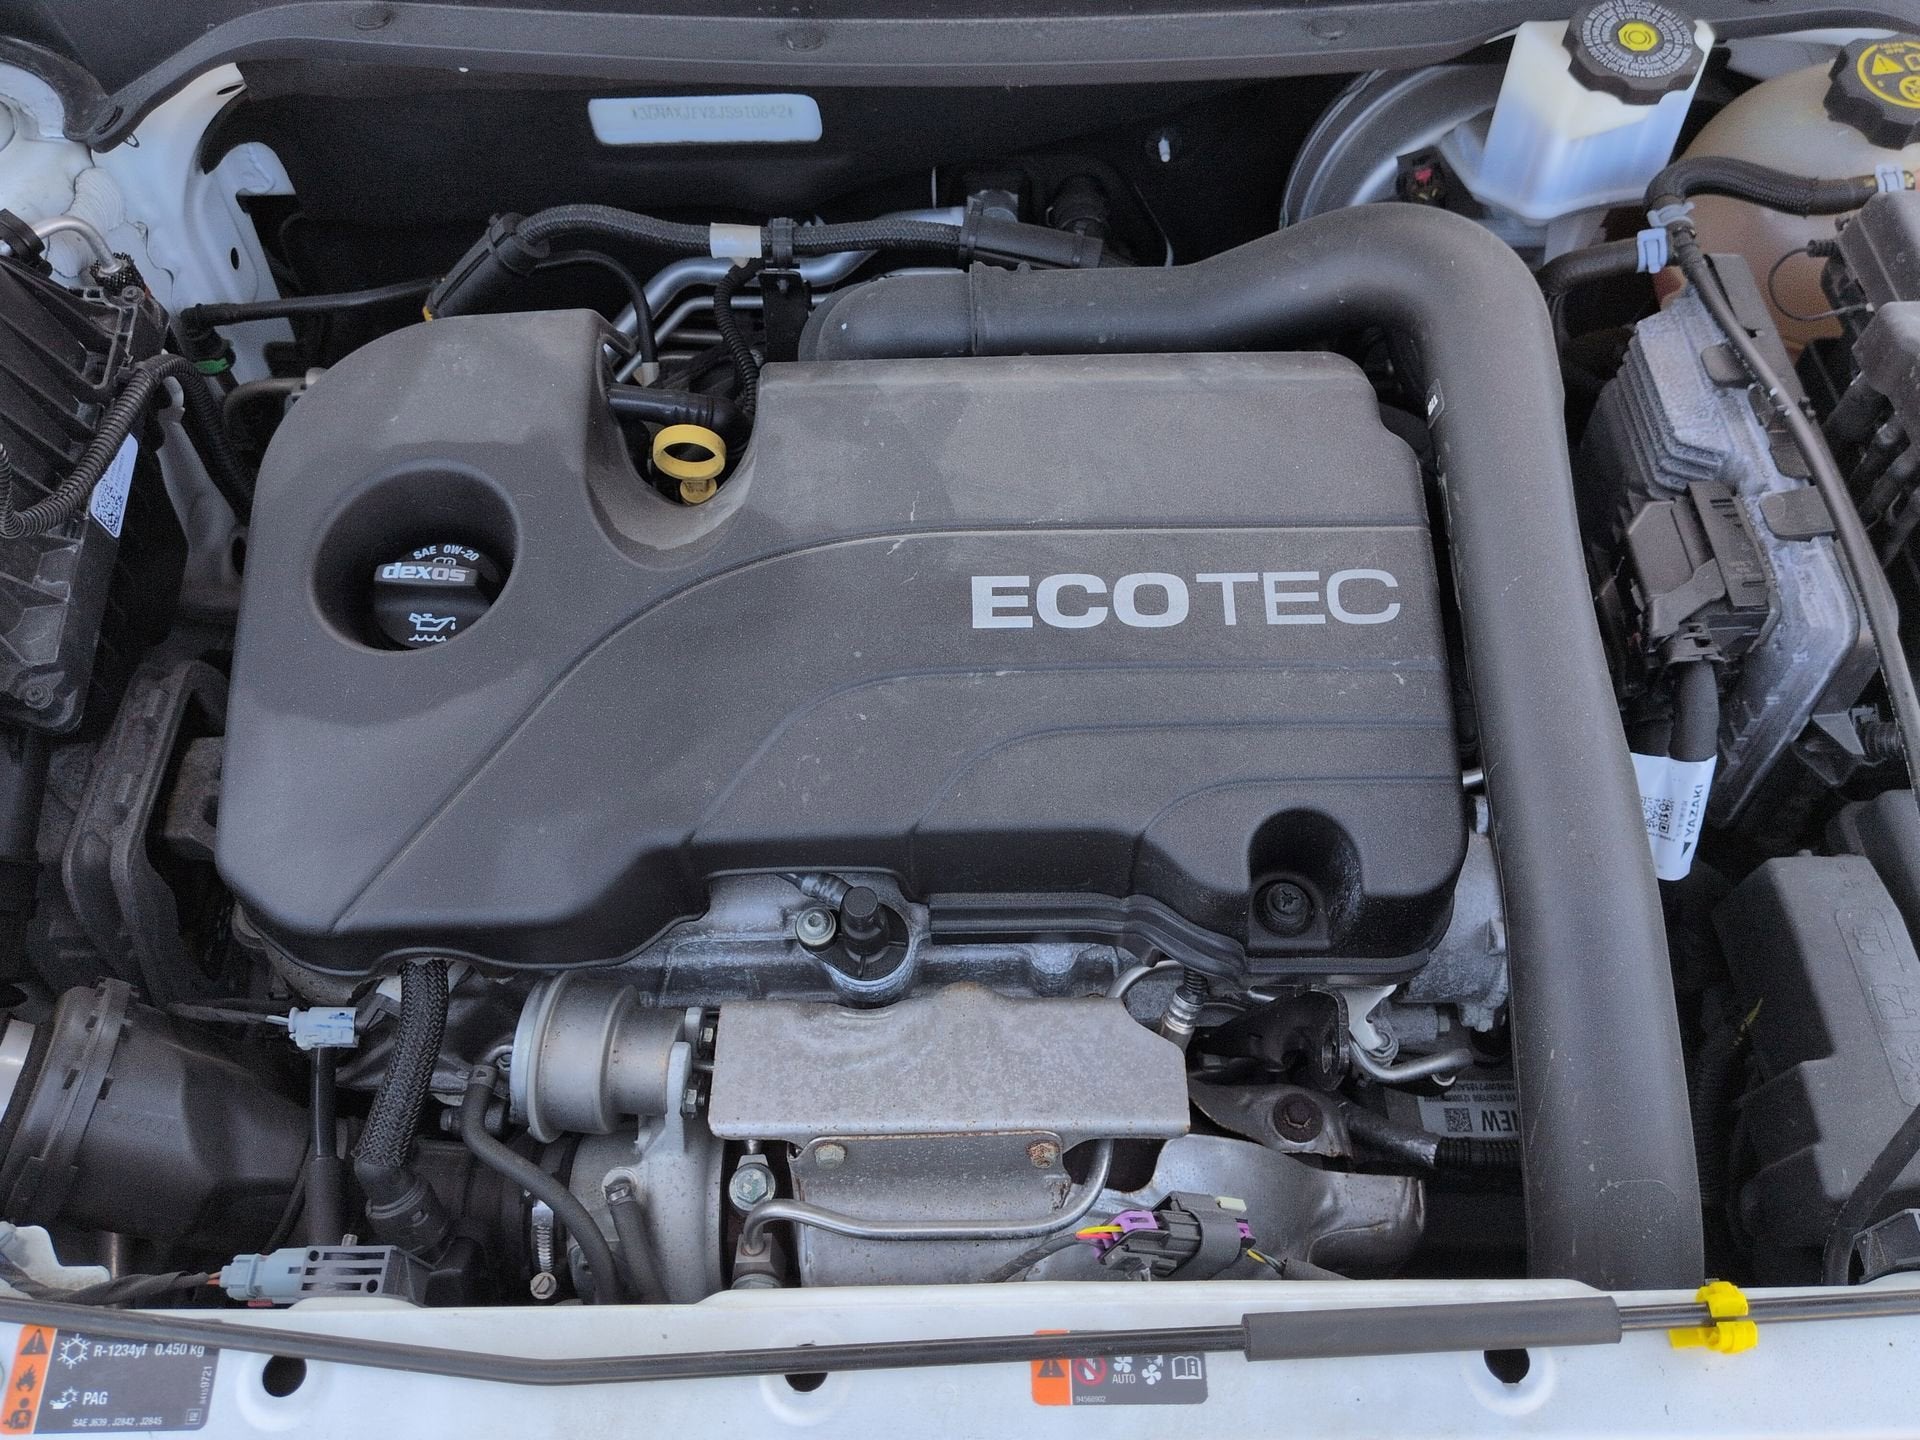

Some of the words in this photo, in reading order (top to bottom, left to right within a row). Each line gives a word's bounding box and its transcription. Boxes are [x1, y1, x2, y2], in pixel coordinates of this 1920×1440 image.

[413, 545, 438, 560] SAE
[443, 544, 480, 562] 0W-20
[382, 562, 470, 582] dexos
[970, 568, 1401, 629] ECOTEC
[1685, 784, 1703, 838] YAZAKI
[93, 1343, 147, 1358] R-1234yf
[154, 1343, 188, 1357] 0.450
[1111, 1373, 1137, 1384] AUTO
[82, 1391, 109, 1406] PAG
[72, 1417, 89, 1427] SAE
